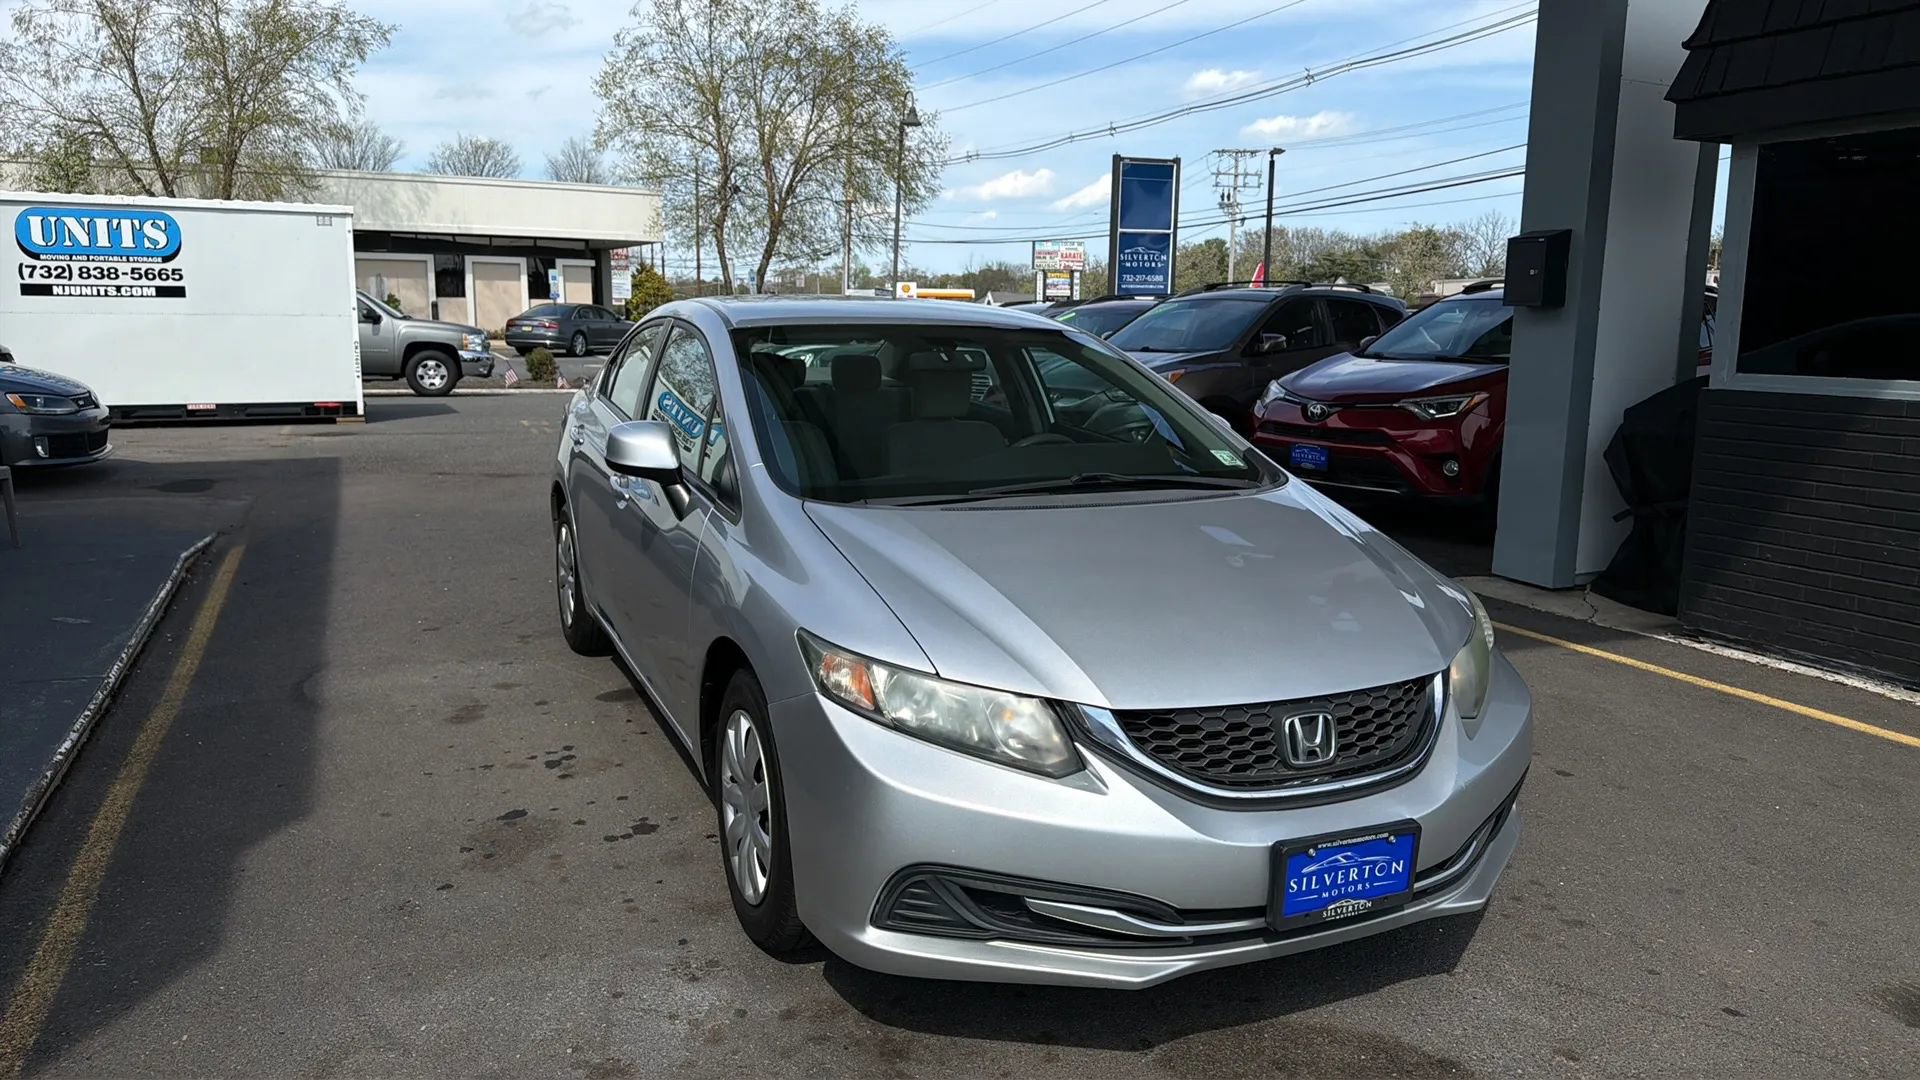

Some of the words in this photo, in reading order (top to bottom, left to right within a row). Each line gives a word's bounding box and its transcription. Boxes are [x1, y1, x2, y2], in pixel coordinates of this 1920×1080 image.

[26, 215, 169, 250] UNITS
[1060, 252, 1083, 260] KARATE
[18, 263, 73, 281] (732)
[78, 266, 184, 282] 838-5665
[52, 285, 157, 297] NJUNITS.COM
[1288, 860, 1404, 893] SILVERTON
[1321, 881, 1371, 898] MOTORS
[1322, 900, 1373, 918] SILVERTON
